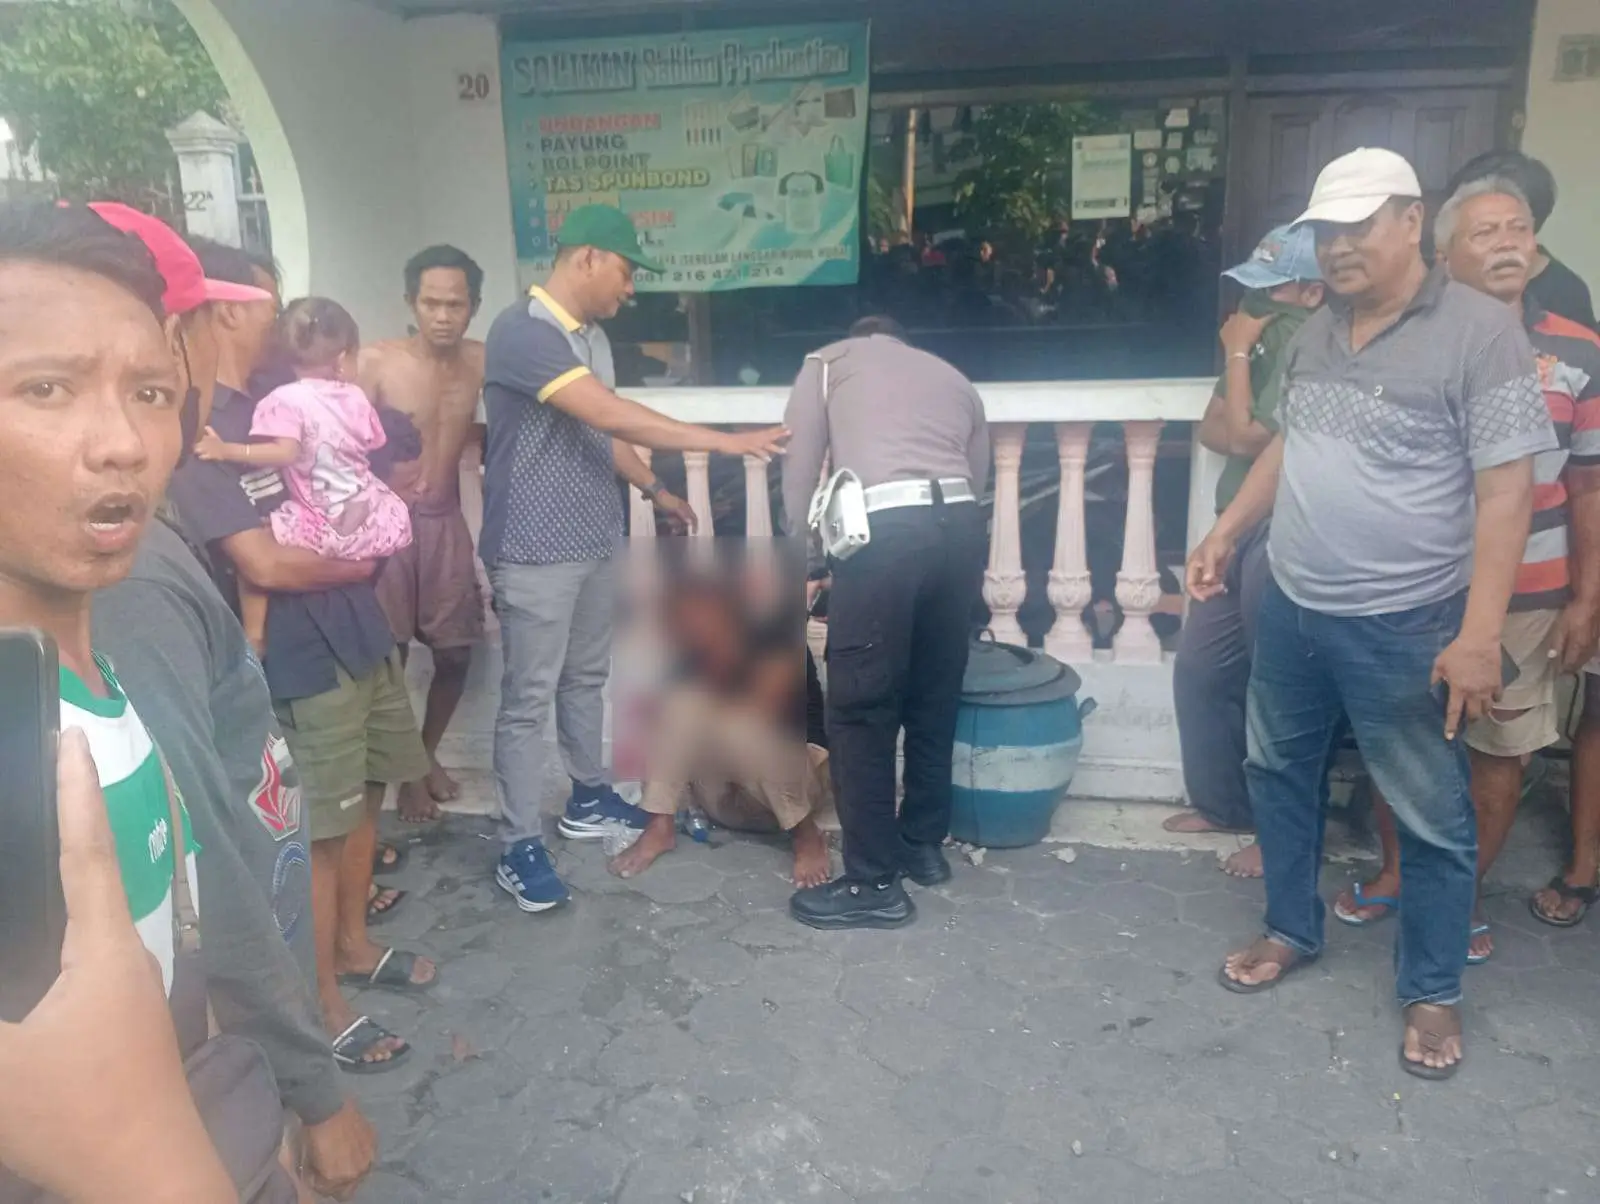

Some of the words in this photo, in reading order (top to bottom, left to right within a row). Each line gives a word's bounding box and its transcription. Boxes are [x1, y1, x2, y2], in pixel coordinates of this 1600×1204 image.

[459, 72, 489, 100] 20
[540, 134, 626, 153] PAYUNG
[542, 152, 650, 172] BOLPOINT
[544, 174, 583, 194] TAS
[586, 168, 710, 192] SPUNBOND
